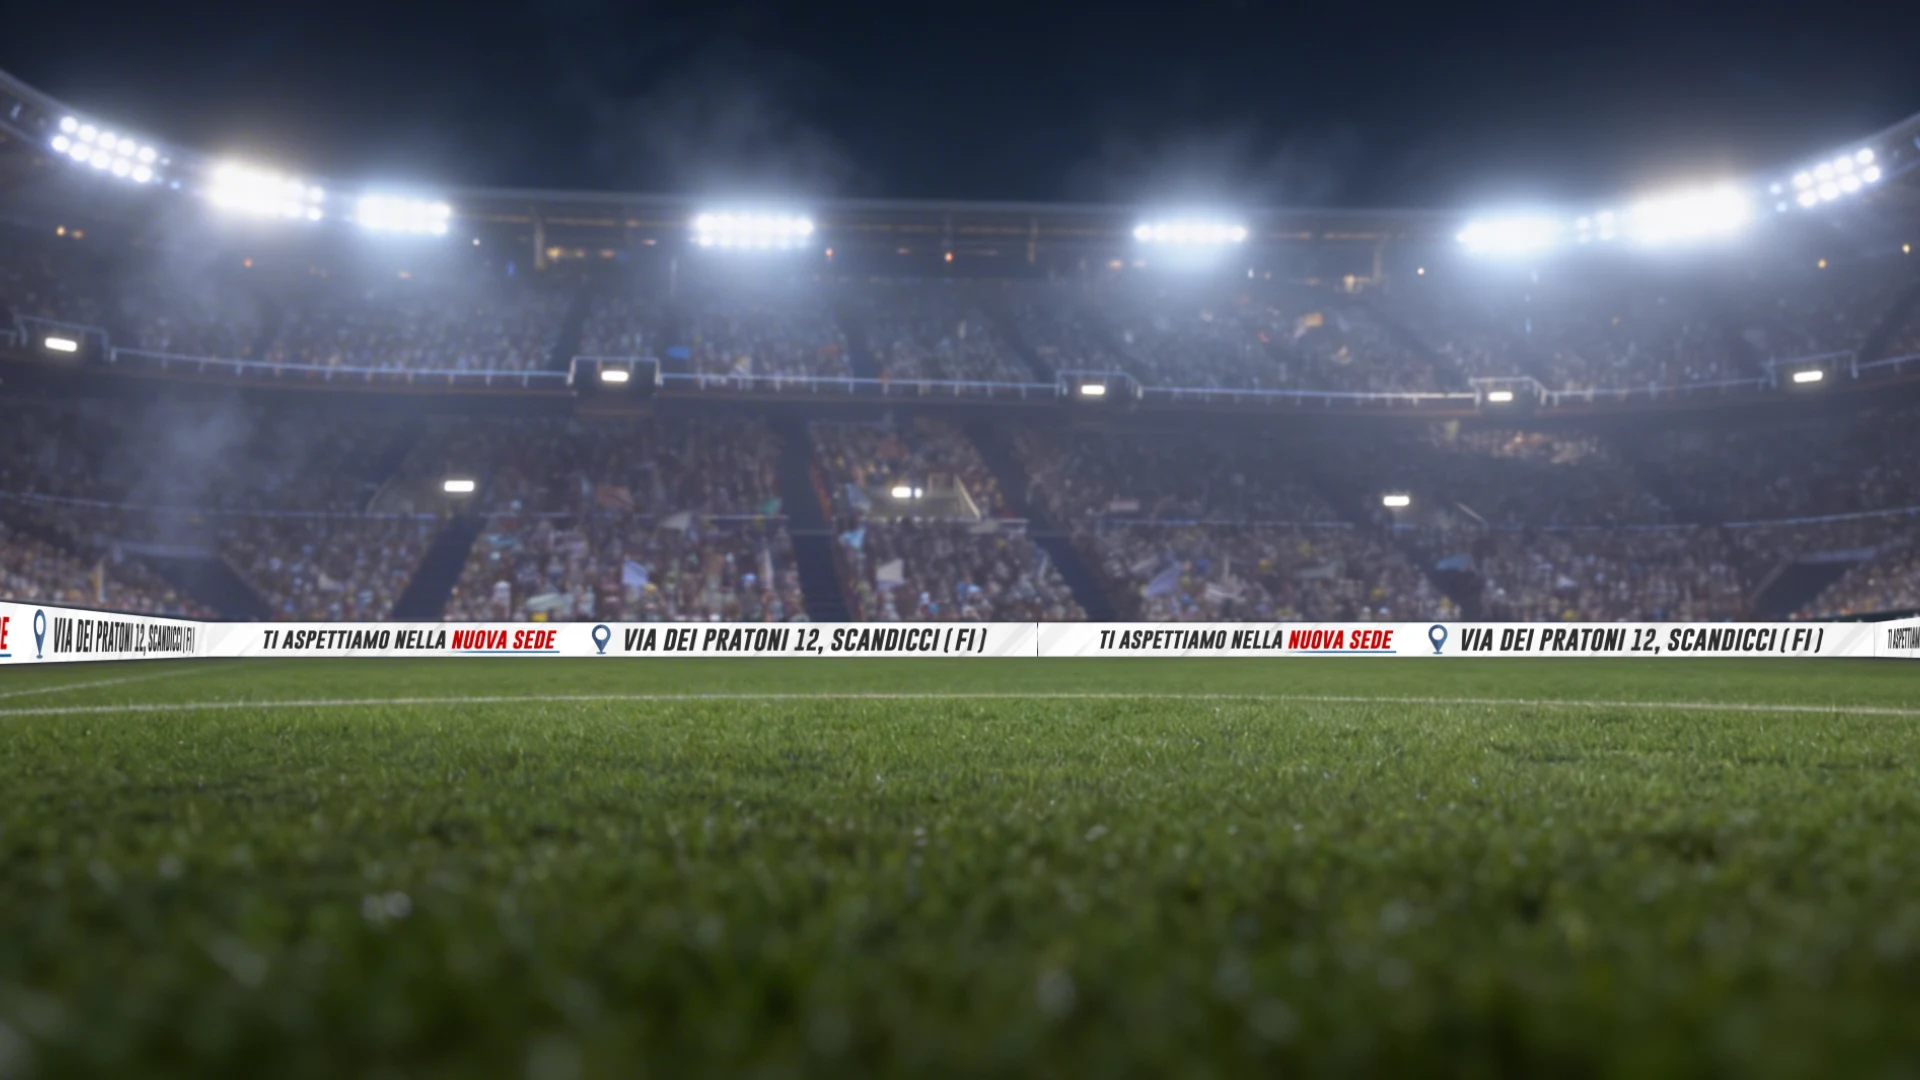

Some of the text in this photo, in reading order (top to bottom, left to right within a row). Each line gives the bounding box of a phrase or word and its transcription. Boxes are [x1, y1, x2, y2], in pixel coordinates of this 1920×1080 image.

[54, 617, 72, 653] VIA
[76, 619, 94, 652] DEI
[96, 620, 134, 652] PRATONI
[135, 623, 146, 656] 12,
[148, 624, 183, 652] SCANDICCI
[264, 630, 278, 650] TI
[282, 630, 390, 650] ASPETTIAMO
[395, 630, 445, 650] NELLA
[451, 630, 507, 650] NUOVA
[513, 630, 556, 650] SEDE
[625, 628, 656, 651] VIA
[664, 628, 697, 651] DEI
[703, 628, 789, 651] PRATONI
[795, 628, 823, 654] 12,
[831, 628, 940, 651] SCANDICCI
[1101, 630, 1115, 650] TI
[1119, 630, 1227, 650] ASPETTIAMO
[1232, 630, 1282, 650] NELLA
[1288, 630, 1344, 650] NUOVA
[1350, 630, 1393, 650] SEDE
[1462, 628, 1493, 651] VIA
[1501, 628, 1534, 651] DEI
[1540, 628, 1626, 651] PRATONI
[1632, 628, 1660, 654] 12,
[1668, 628, 1777, 651] SCANDICCI
